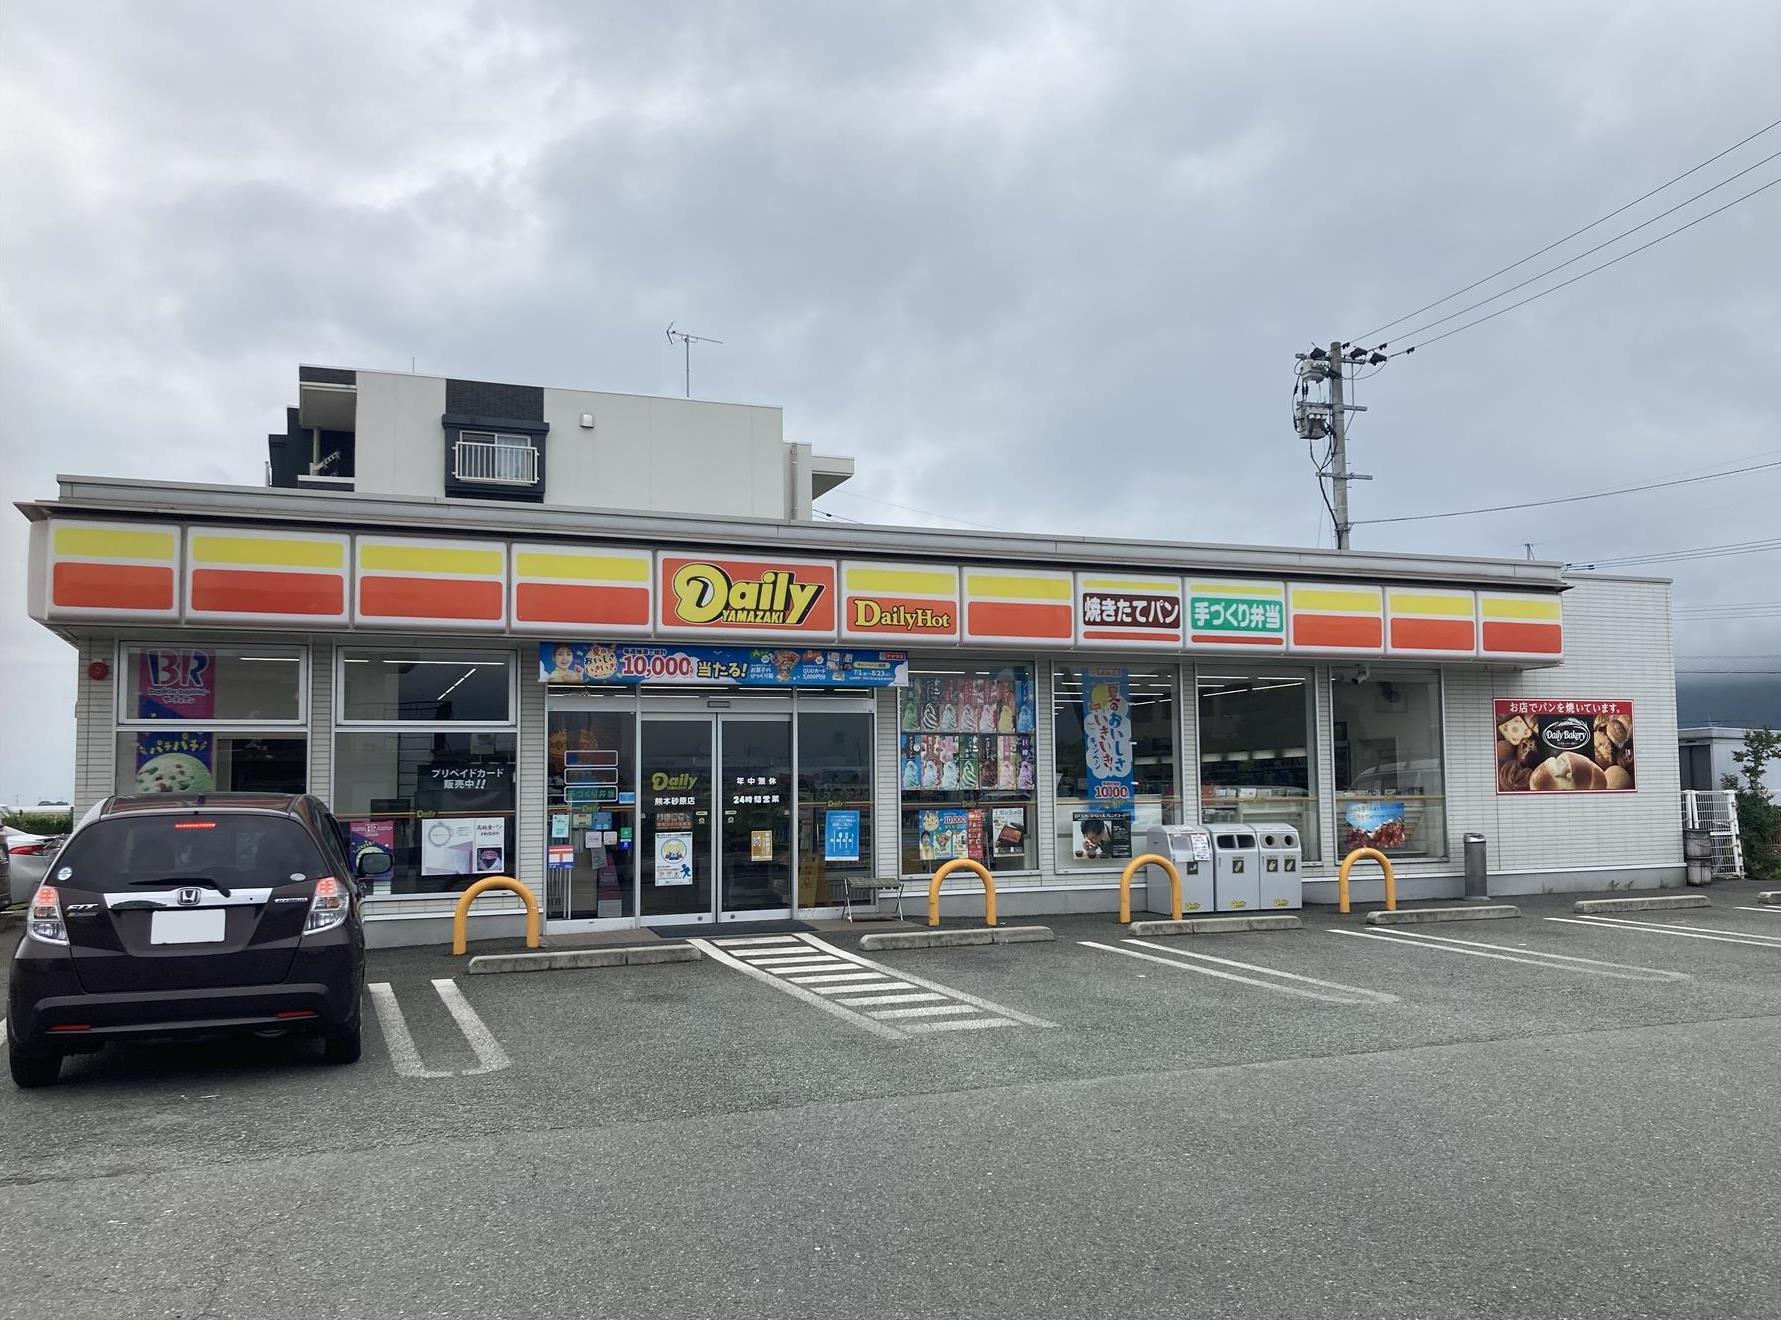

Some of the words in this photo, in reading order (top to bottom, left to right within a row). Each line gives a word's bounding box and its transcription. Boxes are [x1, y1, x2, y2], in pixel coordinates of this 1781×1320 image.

[673, 563, 825, 624] Daily
[722, 609, 784, 624] YAMAZAKI
[1084, 596, 1179, 624] 焼きたてパン
[1193, 601, 1281, 629] 手づくり弁当
[148, 650, 210, 687] BR
[622, 655, 691, 677] 10,000
[1509, 702, 1621, 714] お店でパンを焼いています。
[1546, 729, 1564, 742] Daily
[1563, 730, 1587, 742] Bakery
[431, 768, 504, 779] プリペイドカード
[651, 772, 698, 790] Daily
[736, 776, 778, 786] 年中無休
[654, 796, 696, 806] 熊本砂原店
[733, 794, 780, 805] 24時間営業
